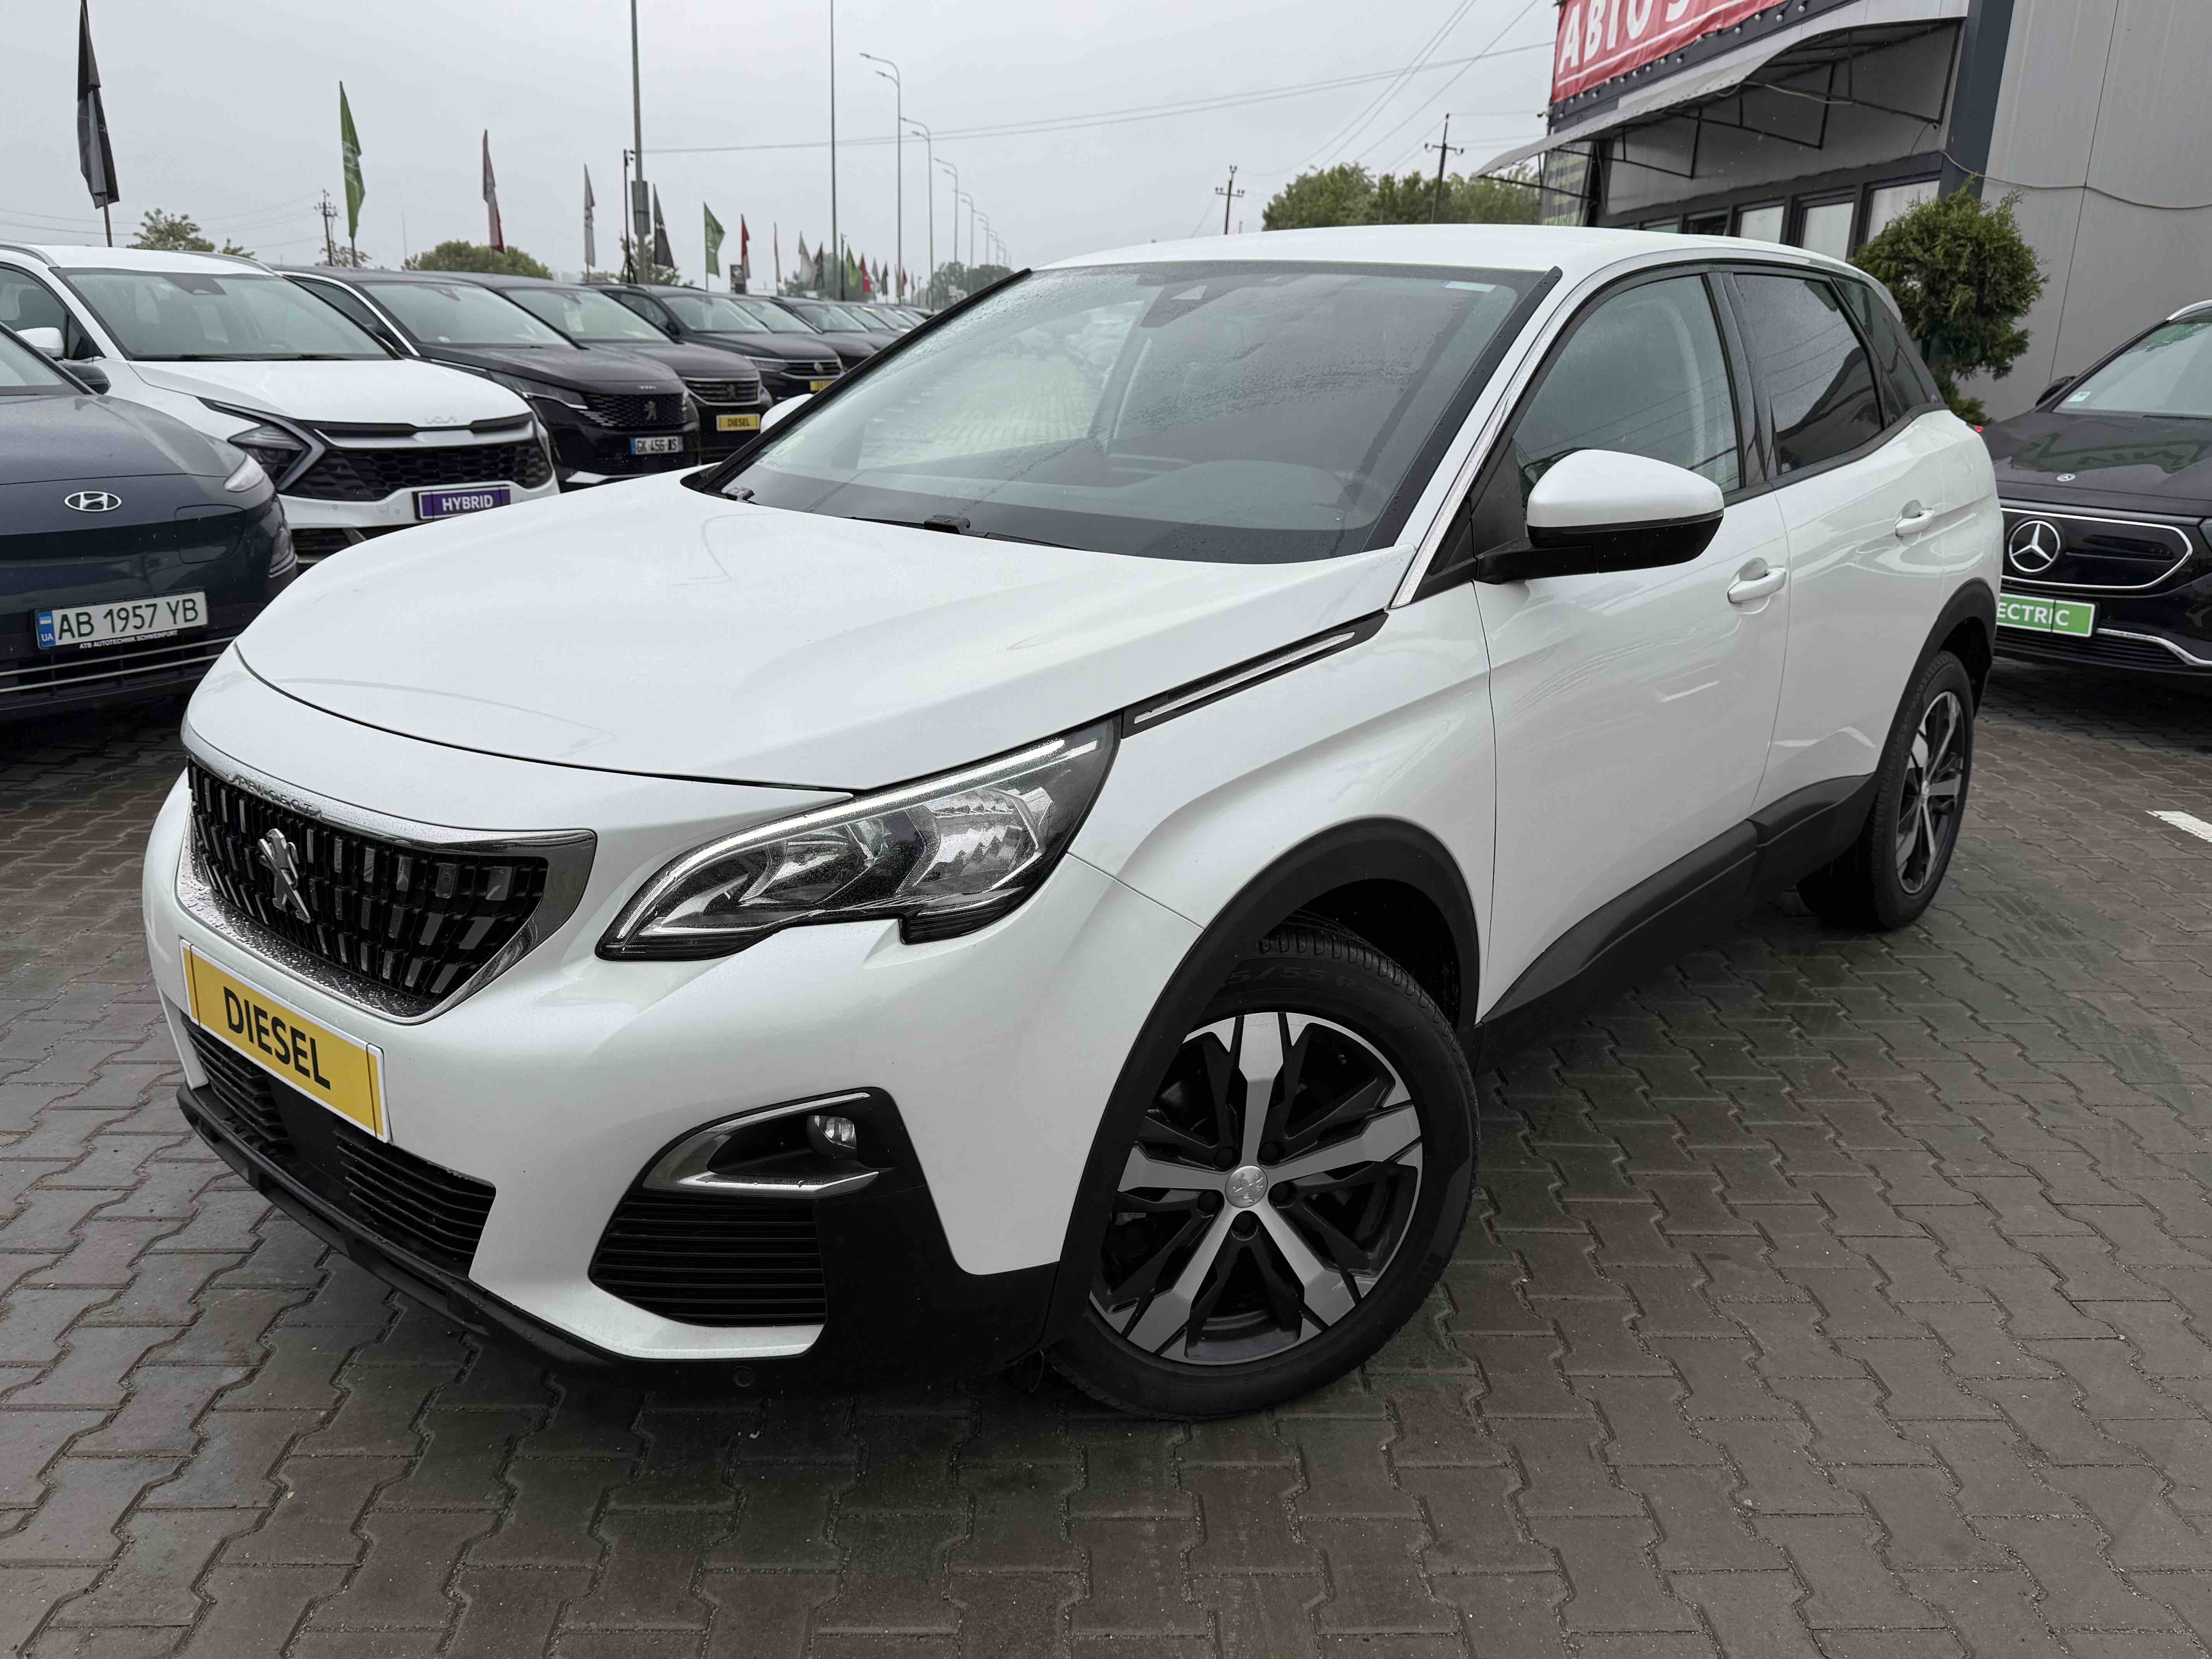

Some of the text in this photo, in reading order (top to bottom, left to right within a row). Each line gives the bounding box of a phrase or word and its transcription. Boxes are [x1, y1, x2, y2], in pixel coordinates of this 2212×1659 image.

[727, 417, 750, 427] DIESEL
[442, 495, 494, 512] HYBRID
[58, 598, 198, 640] AB 1957 YB
[41, 633, 54, 642] UA
[238, 777, 313, 814] PEUGEOT
[223, 986, 331, 1090] DIESEL
